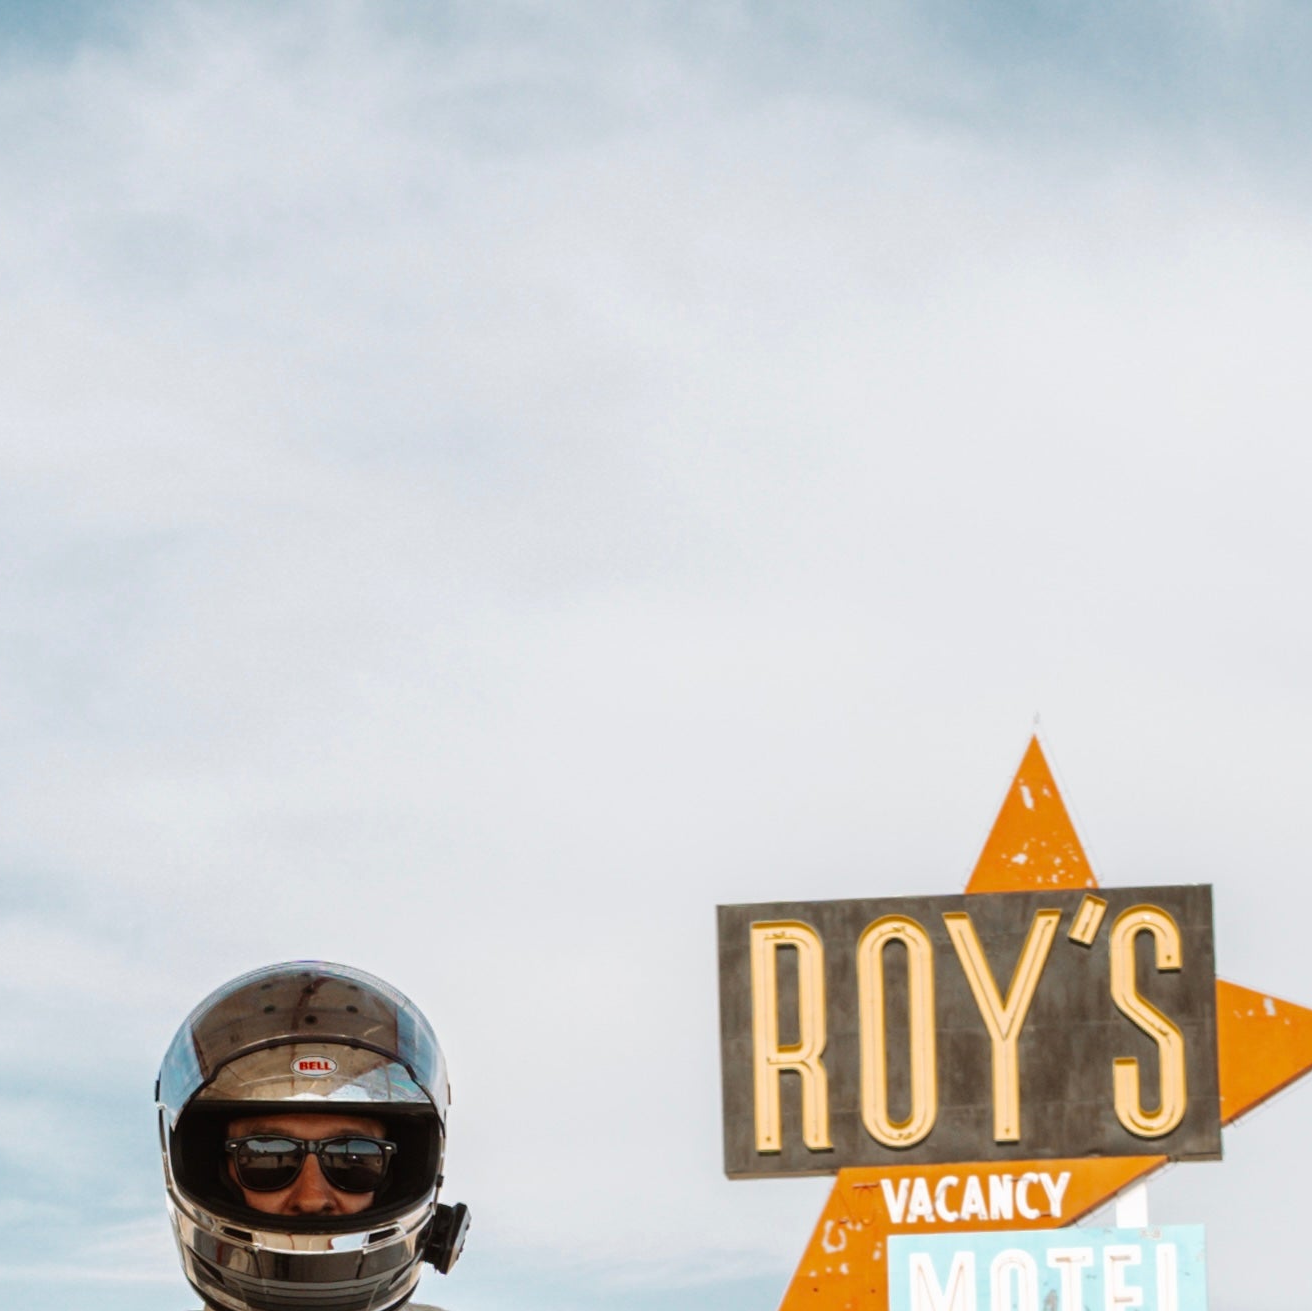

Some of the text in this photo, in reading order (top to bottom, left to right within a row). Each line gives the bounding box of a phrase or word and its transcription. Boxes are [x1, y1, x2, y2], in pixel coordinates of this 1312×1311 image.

[749, 893, 1188, 1154] ROY'S
[299, 1061, 333, 1071] BELL
[880, 1171, 1072, 1224] VACANCY
